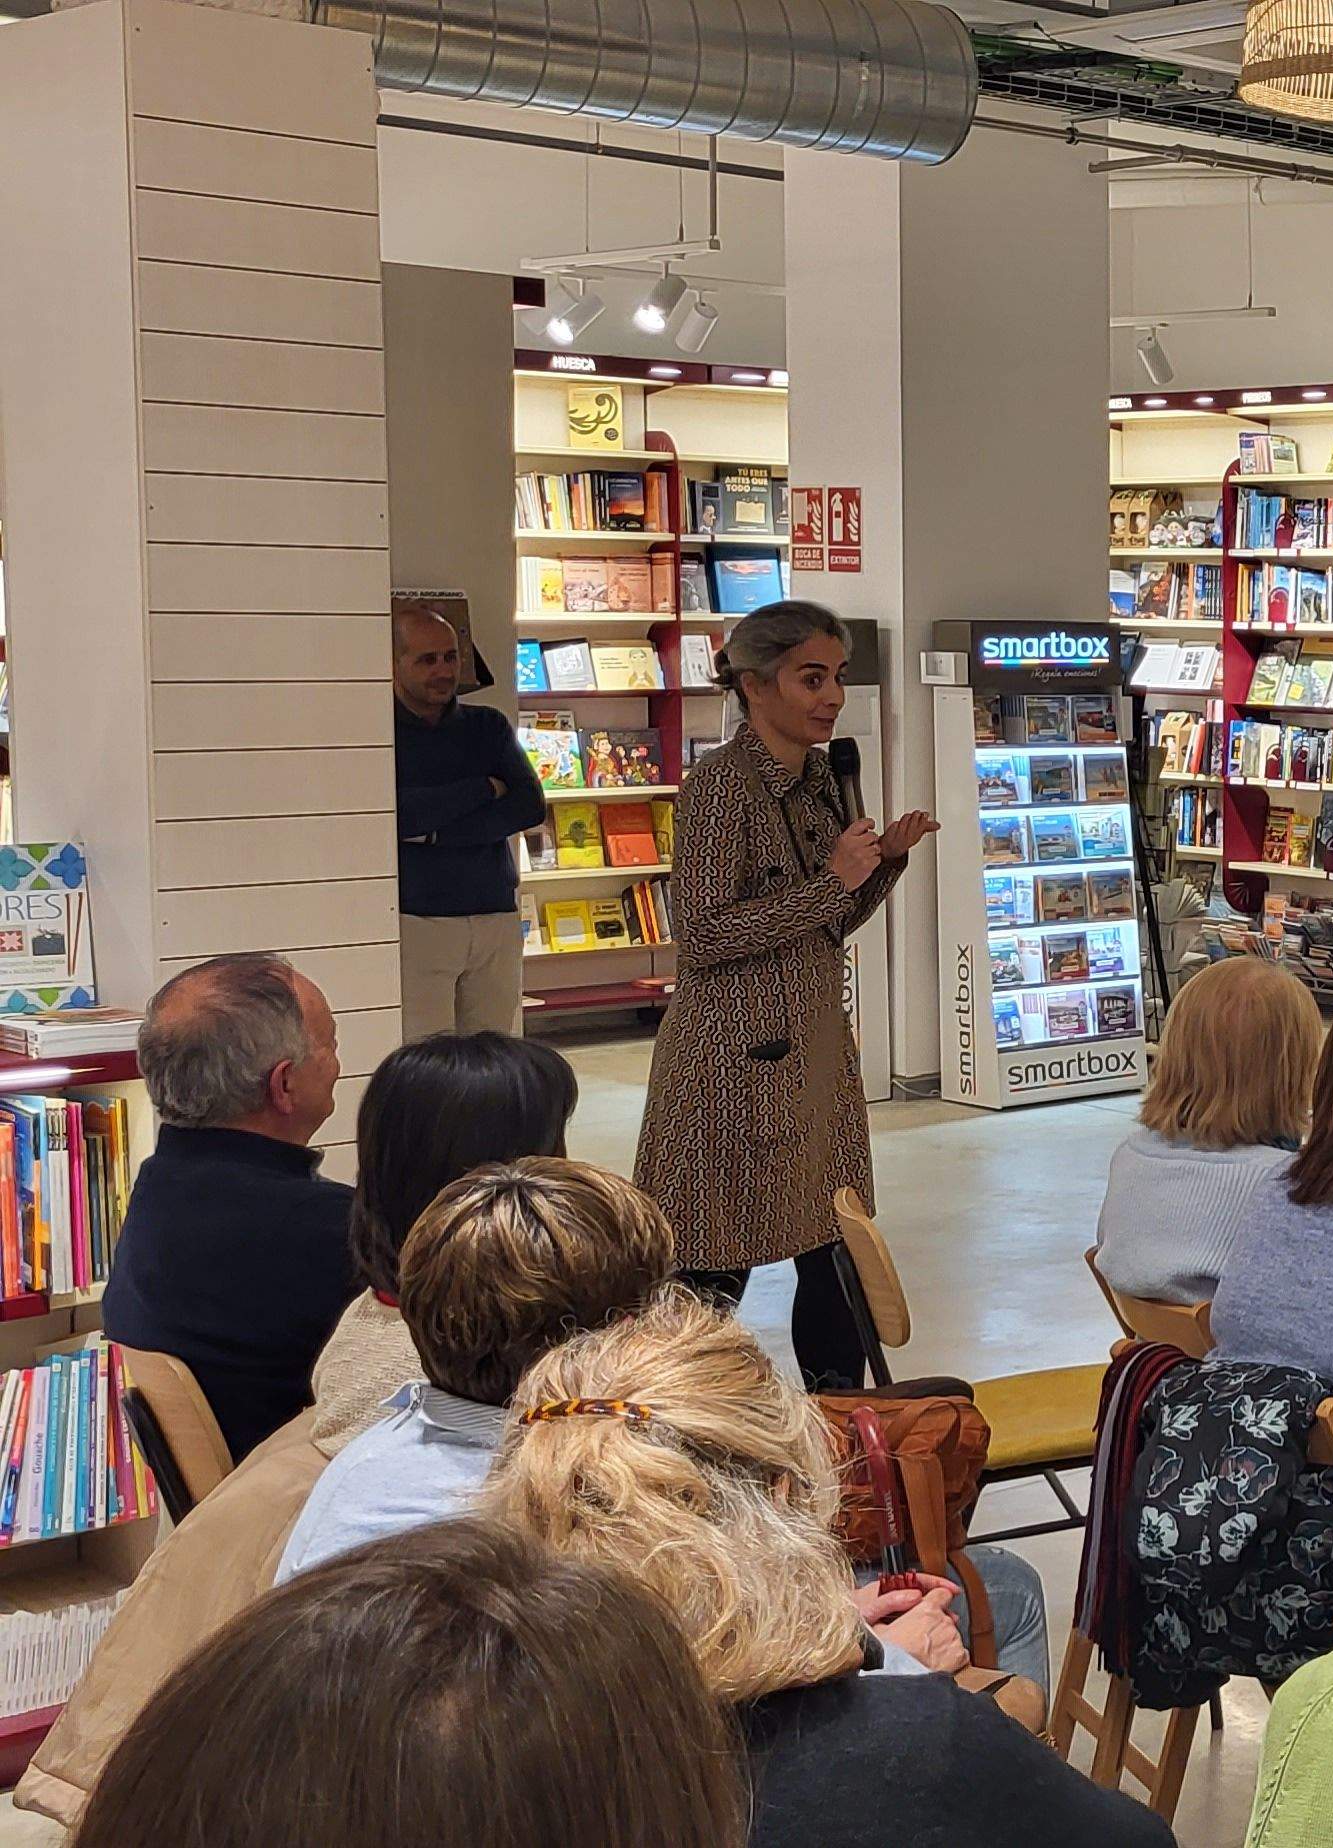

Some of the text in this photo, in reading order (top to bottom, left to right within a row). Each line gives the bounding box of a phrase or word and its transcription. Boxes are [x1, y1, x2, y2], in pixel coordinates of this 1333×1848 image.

[552, 356, 597, 371] HUESCA
[983, 632, 1110, 658] smartbox
[0, 893, 63, 921] RES
[956, 943, 972, 1096] smartbox
[1008, 1050, 1137, 1086] smartbox
[32, 1432, 44, 1474] Gouache
